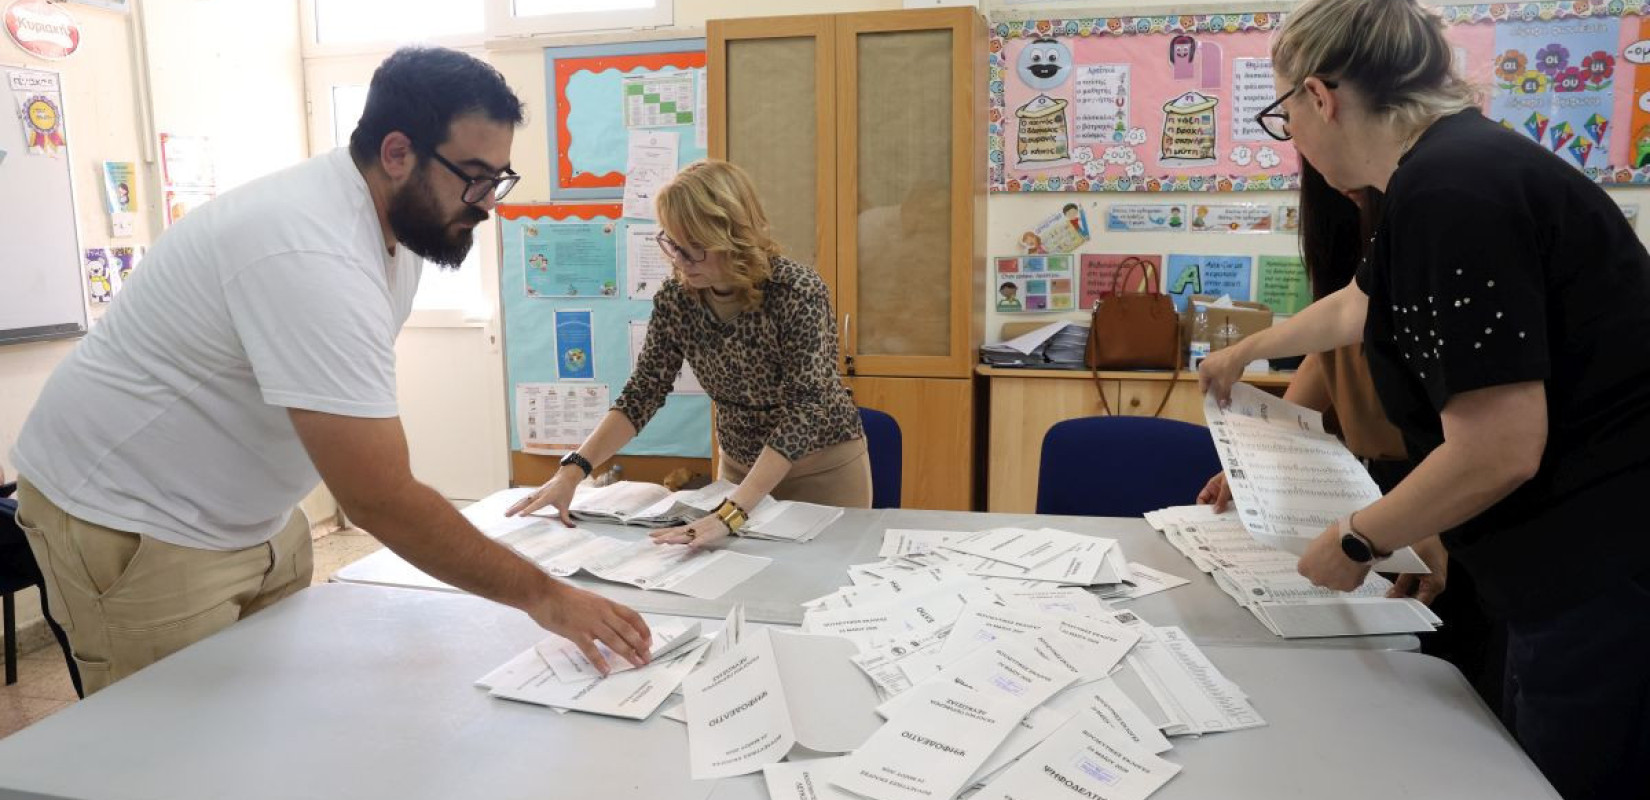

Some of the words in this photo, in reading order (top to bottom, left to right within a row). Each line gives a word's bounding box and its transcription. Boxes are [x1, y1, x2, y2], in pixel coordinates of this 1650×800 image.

[17, 15, 69, 36] Κυριακή
[708, 690, 768, 727] ΨΗΦΟΔΕΛΤΙΟ
[901, 731, 966, 758] ΨΗΦΟΔΕΛΤΙΟ
